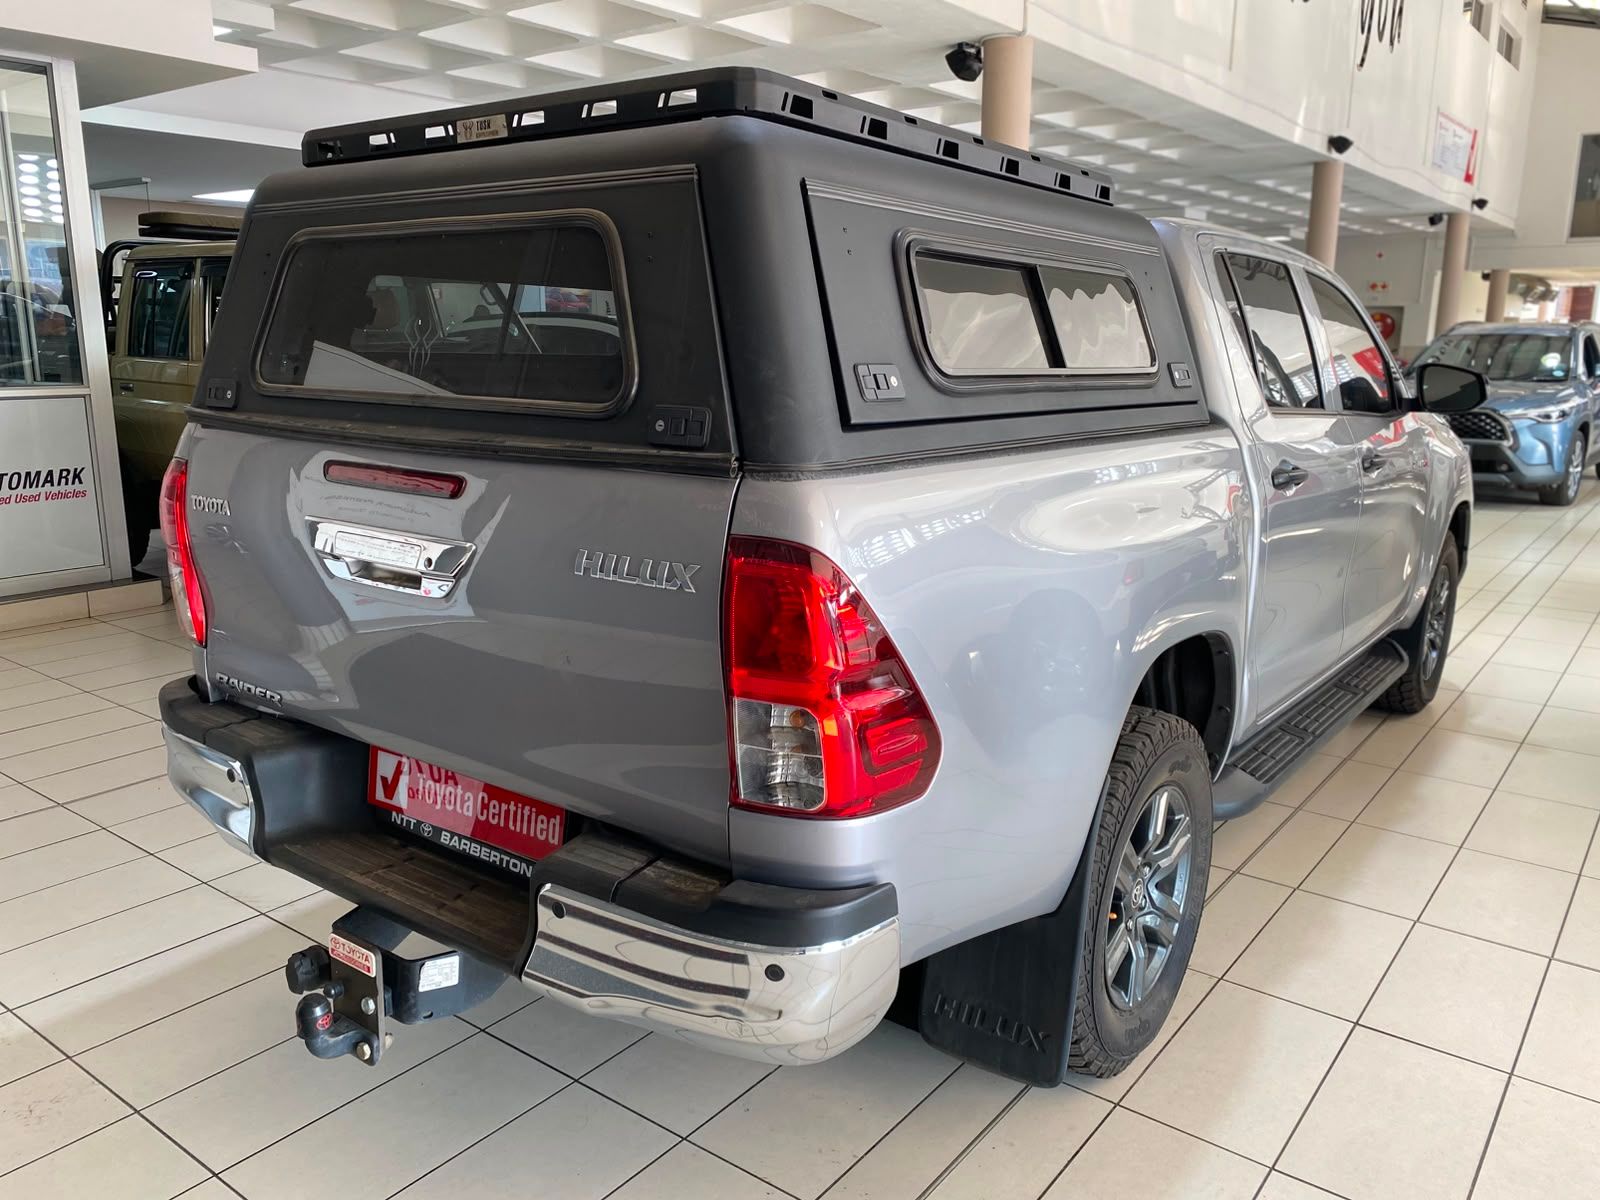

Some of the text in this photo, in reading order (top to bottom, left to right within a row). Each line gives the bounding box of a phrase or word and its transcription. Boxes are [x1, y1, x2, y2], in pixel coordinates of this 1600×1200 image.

[15, 492, 41, 504] Used
[45, 489, 88, 501] Vehicles
[191, 495, 231, 516] TOYOTA
[574, 548, 701, 593] HILUX
[417, 773, 561, 845] Toyota Certified
[392, 811, 533, 878] NTT BARBERTON
[340, 942, 371, 964] TOYOTA
[934, 993, 1050, 1054] HILUX
